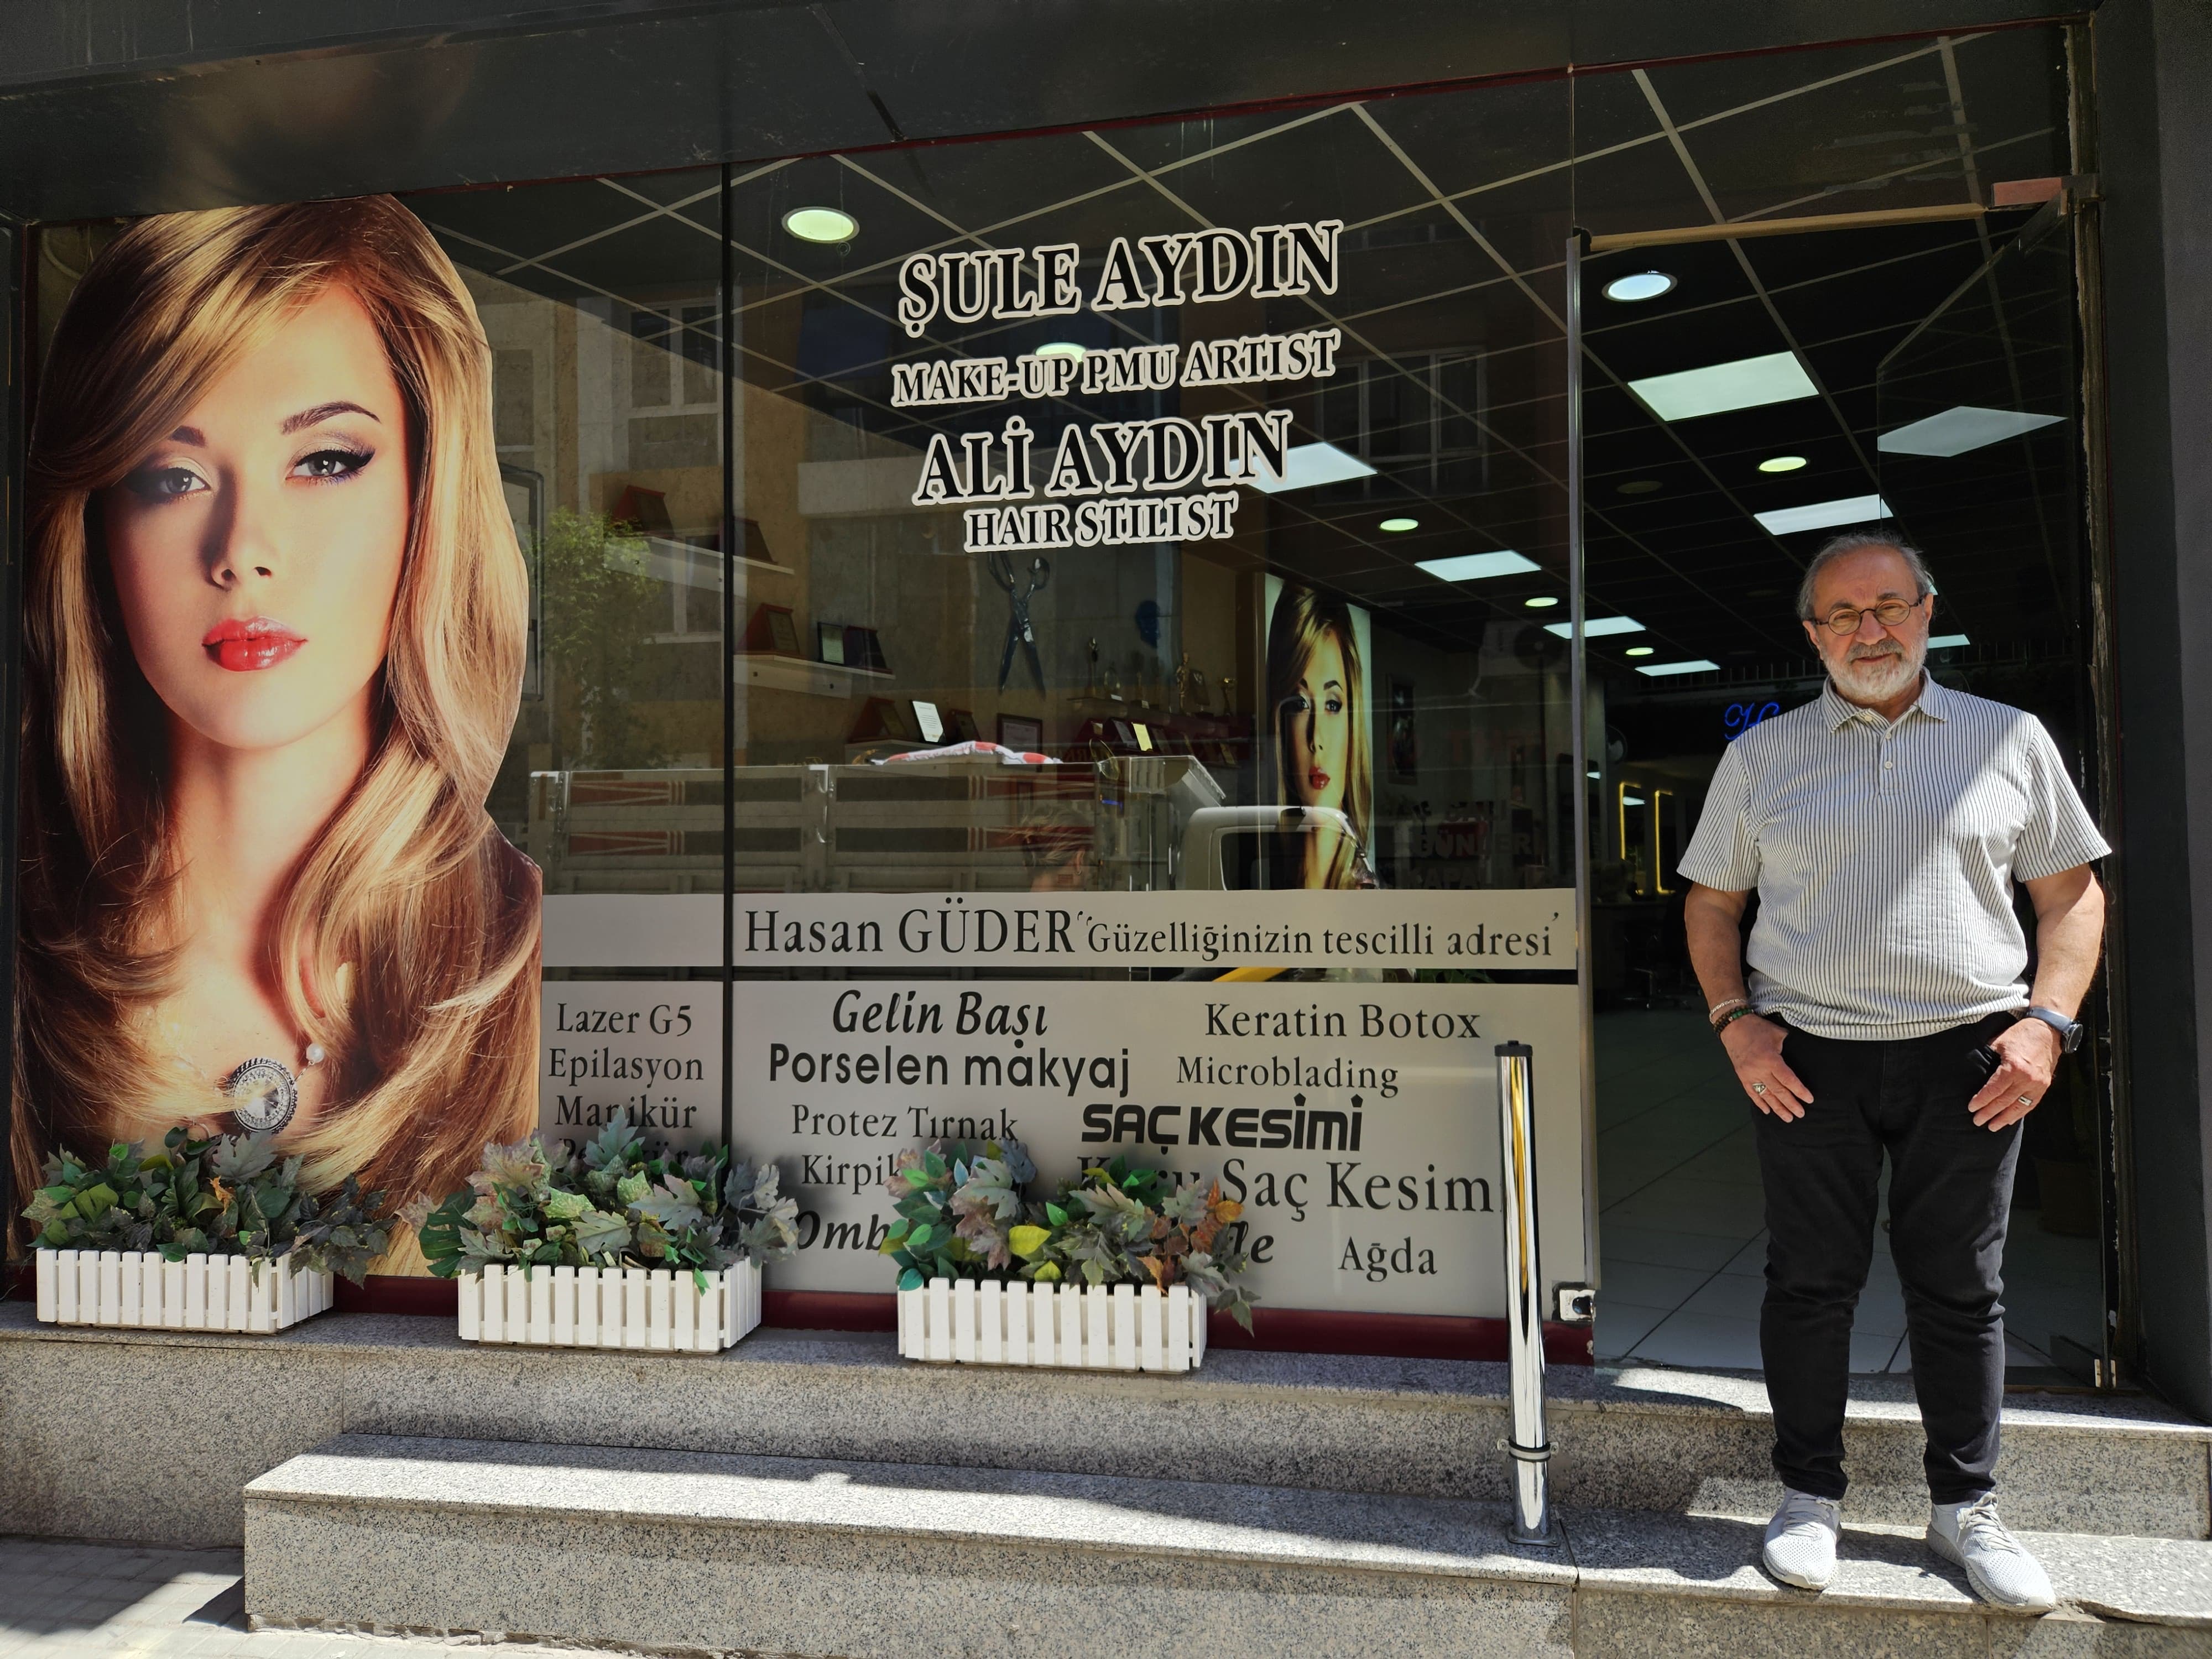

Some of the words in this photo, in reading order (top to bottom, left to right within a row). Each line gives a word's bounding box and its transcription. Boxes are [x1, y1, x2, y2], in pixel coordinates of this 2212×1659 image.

[898, 243, 1082, 337] ŞULE
[1091, 219, 1344, 311] AYDIN
[891, 353, 1079, 408] MAKE-UP
[1081, 344, 1178, 395] PMU
[1180, 328, 1341, 389] ARTIST
[912, 415, 1035, 507] ALİ
[1045, 409, 1293, 496] AYDIN
[964, 502, 1073, 553] HAIR
[1074, 491, 1238, 547] STILIST
[745, 911, 883, 952] Hasan
[898, 897, 1075, 953] GÜDER
[1323, 922, 1433, 955] tescilli
[556, 1003, 640, 1033] Lazer
[649, 1004, 692, 1037] G5
[833, 990, 943, 1034] Gelin
[956, 991, 1048, 1048] Başı
[1205, 1004, 1347, 1037] Keratin
[1359, 1004, 1481, 1039] Botox
[549, 1047, 704, 1088] Epilasyon
[770, 1043, 948, 1085] Porselen
[964, 1047, 1129, 1098] makyaj
[1177, 1056, 1399, 1098] Microblading
[792, 1104, 897, 1137] Protez
[907, 1106, 1019, 1141] Tırnak
[1082, 1104, 1181, 1155] SAÇ
[1223, 1158, 1308, 1222] Saç
[1326, 1161, 1502, 1213] Kesim
[795, 1210, 891, 1250] Omb
[1338, 1236, 1438, 1282] Ağda
